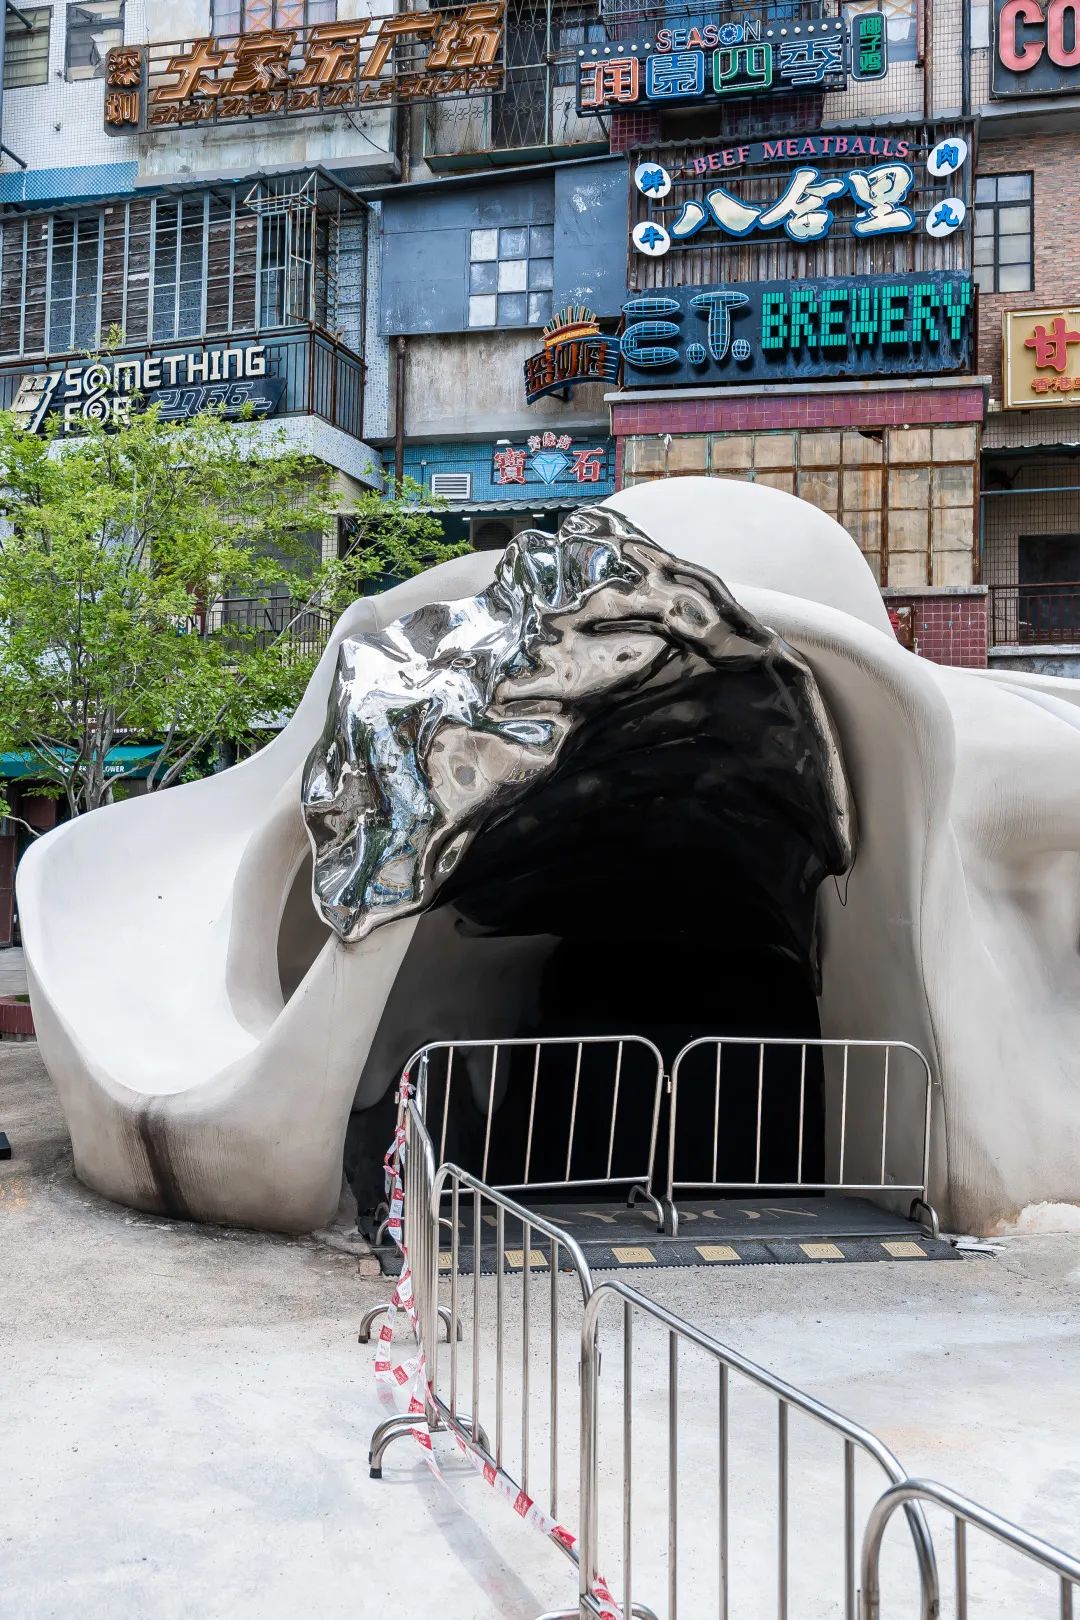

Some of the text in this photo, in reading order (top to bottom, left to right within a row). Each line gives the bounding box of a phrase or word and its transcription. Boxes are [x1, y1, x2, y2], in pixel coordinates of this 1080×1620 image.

[656, 20, 761, 53] SEASON
[106, 49, 142, 126] 深圳
[399, 67, 506, 99] SQUARE
[693, 136, 910, 176] BEEF MEATBALLS
[620, 291, 750, 367] E.T.
[761, 281, 970, 349] BREWERY
[1024, 317, 1080, 372] 甘
[64, 345, 266, 398] SOMETHING
[1032, 377, 1080, 392] 香港
